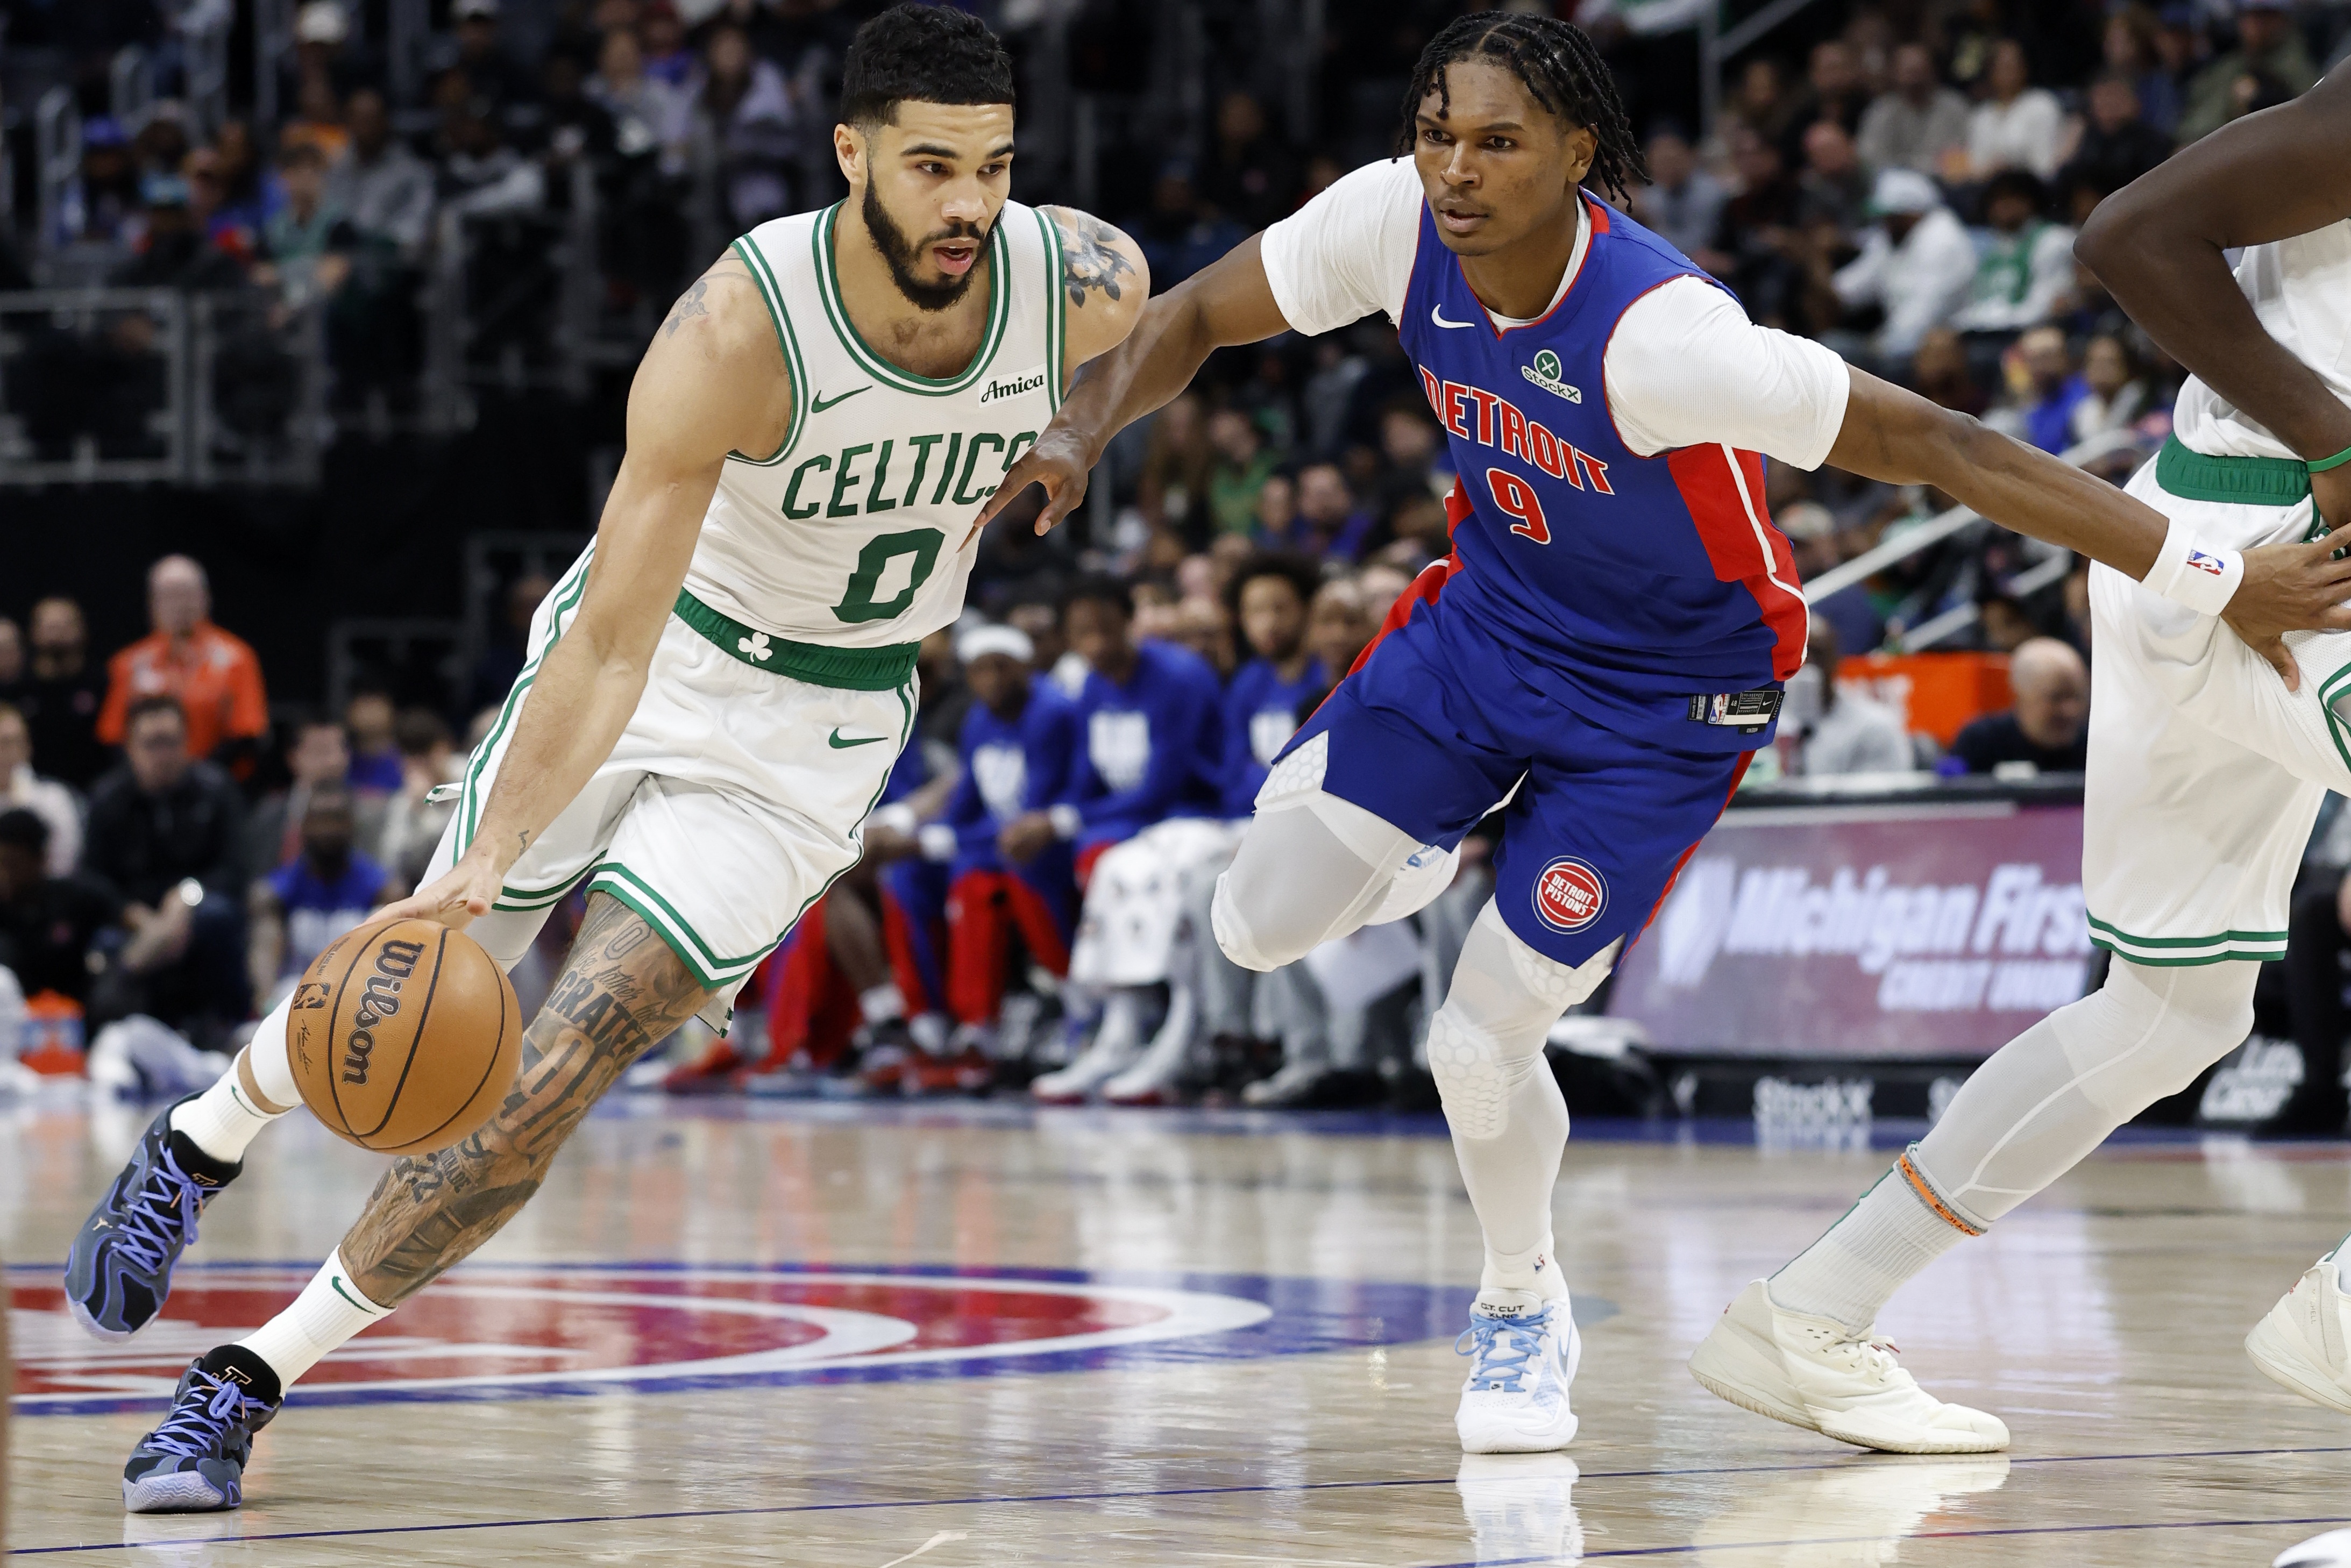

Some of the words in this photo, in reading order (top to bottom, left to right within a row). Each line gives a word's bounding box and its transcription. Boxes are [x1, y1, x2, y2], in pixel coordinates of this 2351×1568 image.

[981, 374, 1044, 403] Amica
[1418, 364, 1615, 495] DETROIT
[1486, 467, 1551, 545] 9
[829, 527, 946, 624] 0
[1545, 883, 1589, 916] PISTONS
[1551, 873, 1594, 906] DETROIT
[1723, 864, 1978, 974] Michigan
[342, 939, 427, 1086] Wilson
